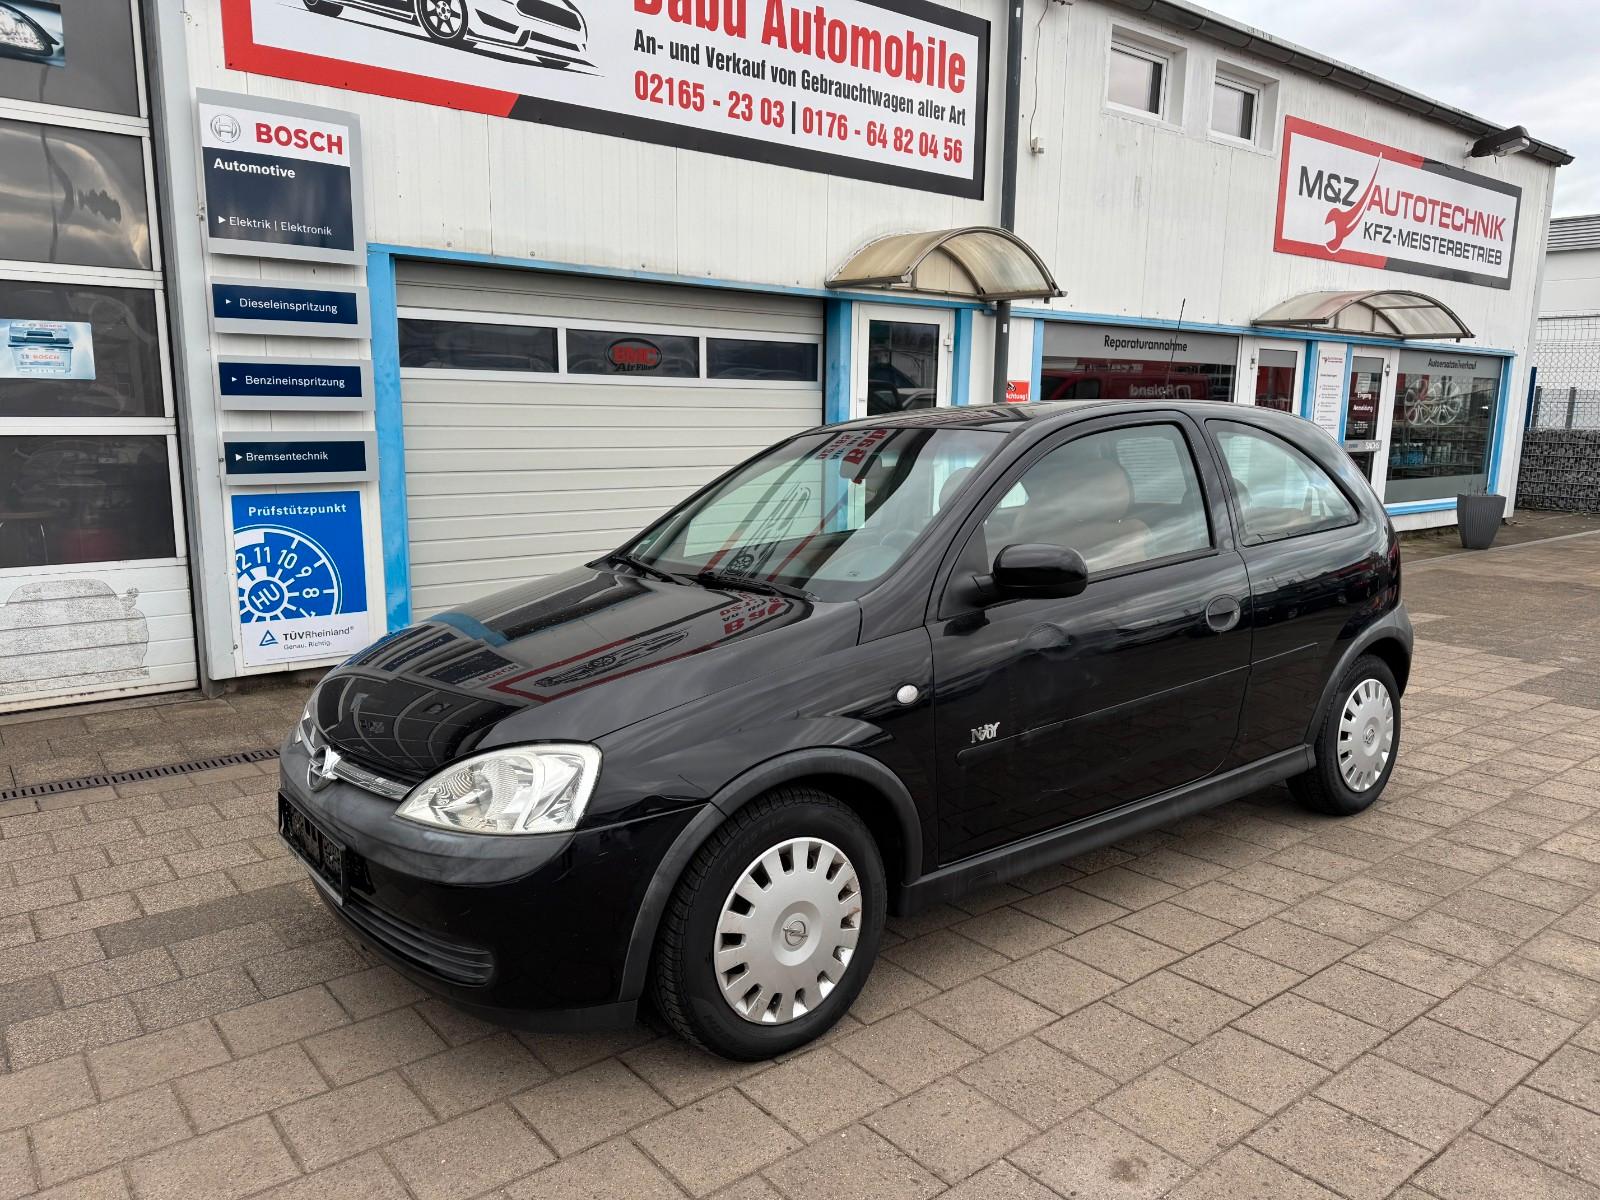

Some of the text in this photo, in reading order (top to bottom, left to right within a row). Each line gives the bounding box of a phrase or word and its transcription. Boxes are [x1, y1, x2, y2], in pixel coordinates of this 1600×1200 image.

[761, 0, 966, 94] Automobile
[634, 28, 966, 126] An- und Verkauf von Gebrauchtwagen aller Art
[634, 70, 705, 112] 02165
[728, 90, 753, 122] 23
[760, 97, 785, 128] 03
[802, 106, 848, 141] 0176
[866, 120, 888, 149] 64
[893, 126, 914, 154] 82
[918, 131, 939, 159] 04
[943, 136, 963, 163] 56
[255, 122, 343, 155] BOSCH
[213, 158, 296, 179] Automotive
[1298, 165, 1506, 242] M&Z AUTOTECHNIK
[229, 216, 272, 230] Elektrik
[281, 221, 332, 236] Elektronik
[239, 298, 338, 314] Dieseleinspritzung
[1104, 335, 1188, 351] Reparaturannahme
[245, 375, 345, 388] Benzineinspritzung
[246, 451, 329, 461] Bremsentechnik
[248, 504, 347, 516] Prüfstützpunkt
[277, 549, 298, 569] 10
[251, 583, 280, 610] HU
[283, 639, 332, 650] Genau. Richtig.
